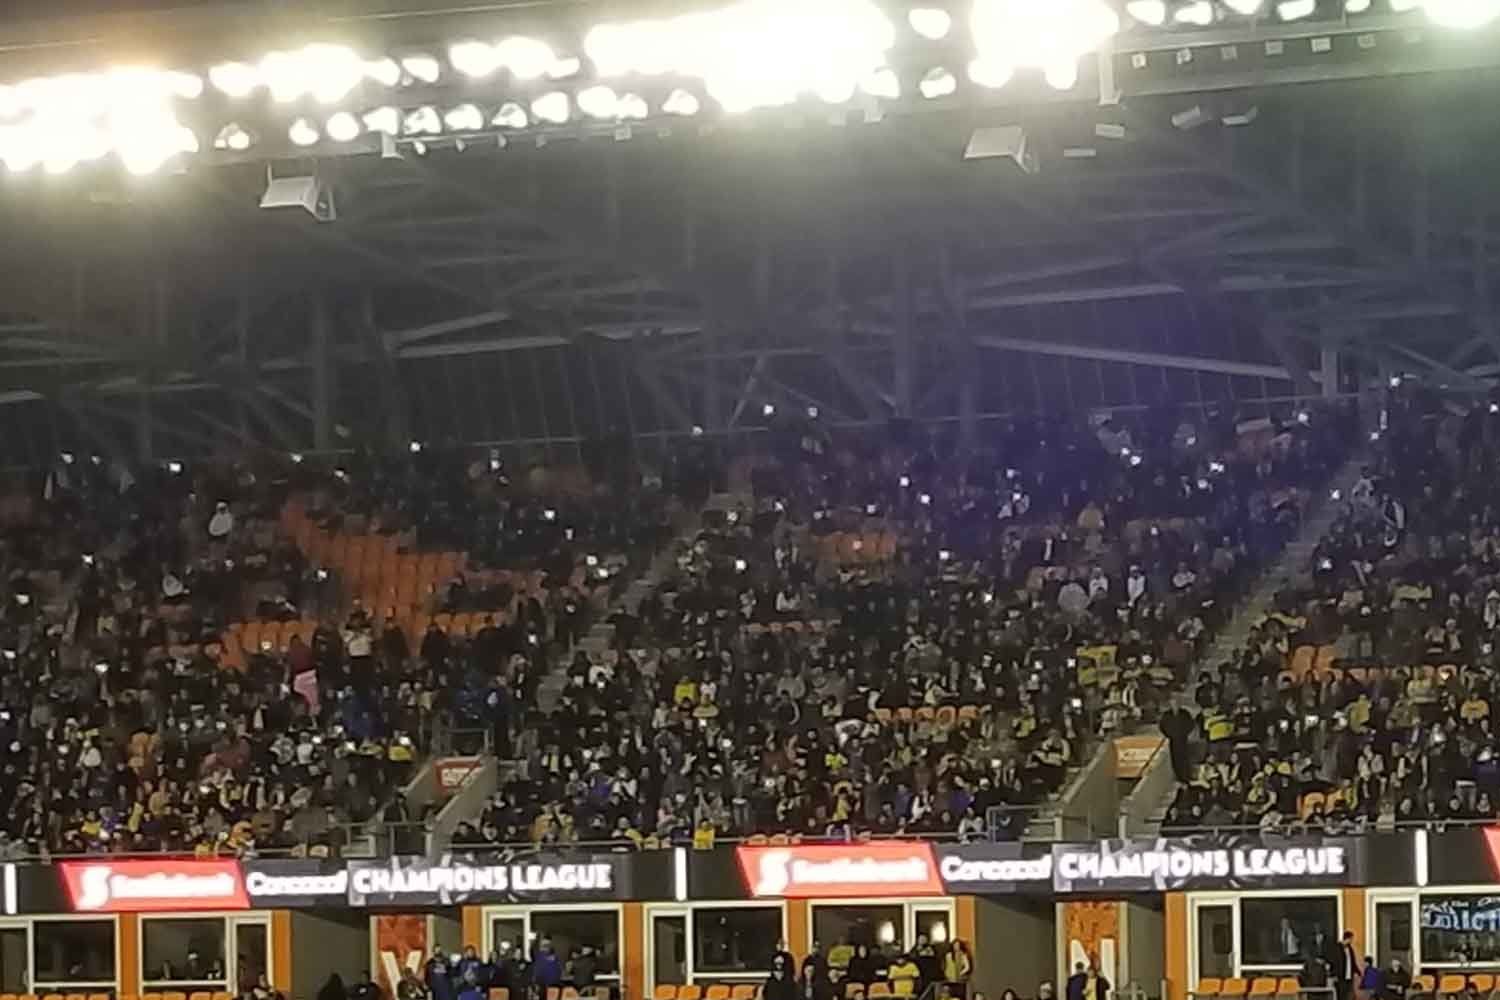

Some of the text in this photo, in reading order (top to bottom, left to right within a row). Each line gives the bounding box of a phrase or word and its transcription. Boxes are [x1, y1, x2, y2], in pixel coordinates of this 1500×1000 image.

[352, 863, 612, 893] CHAMPIONS LEAGUE
[1059, 847, 1345, 879] CHAMPIONS LEAGUE
